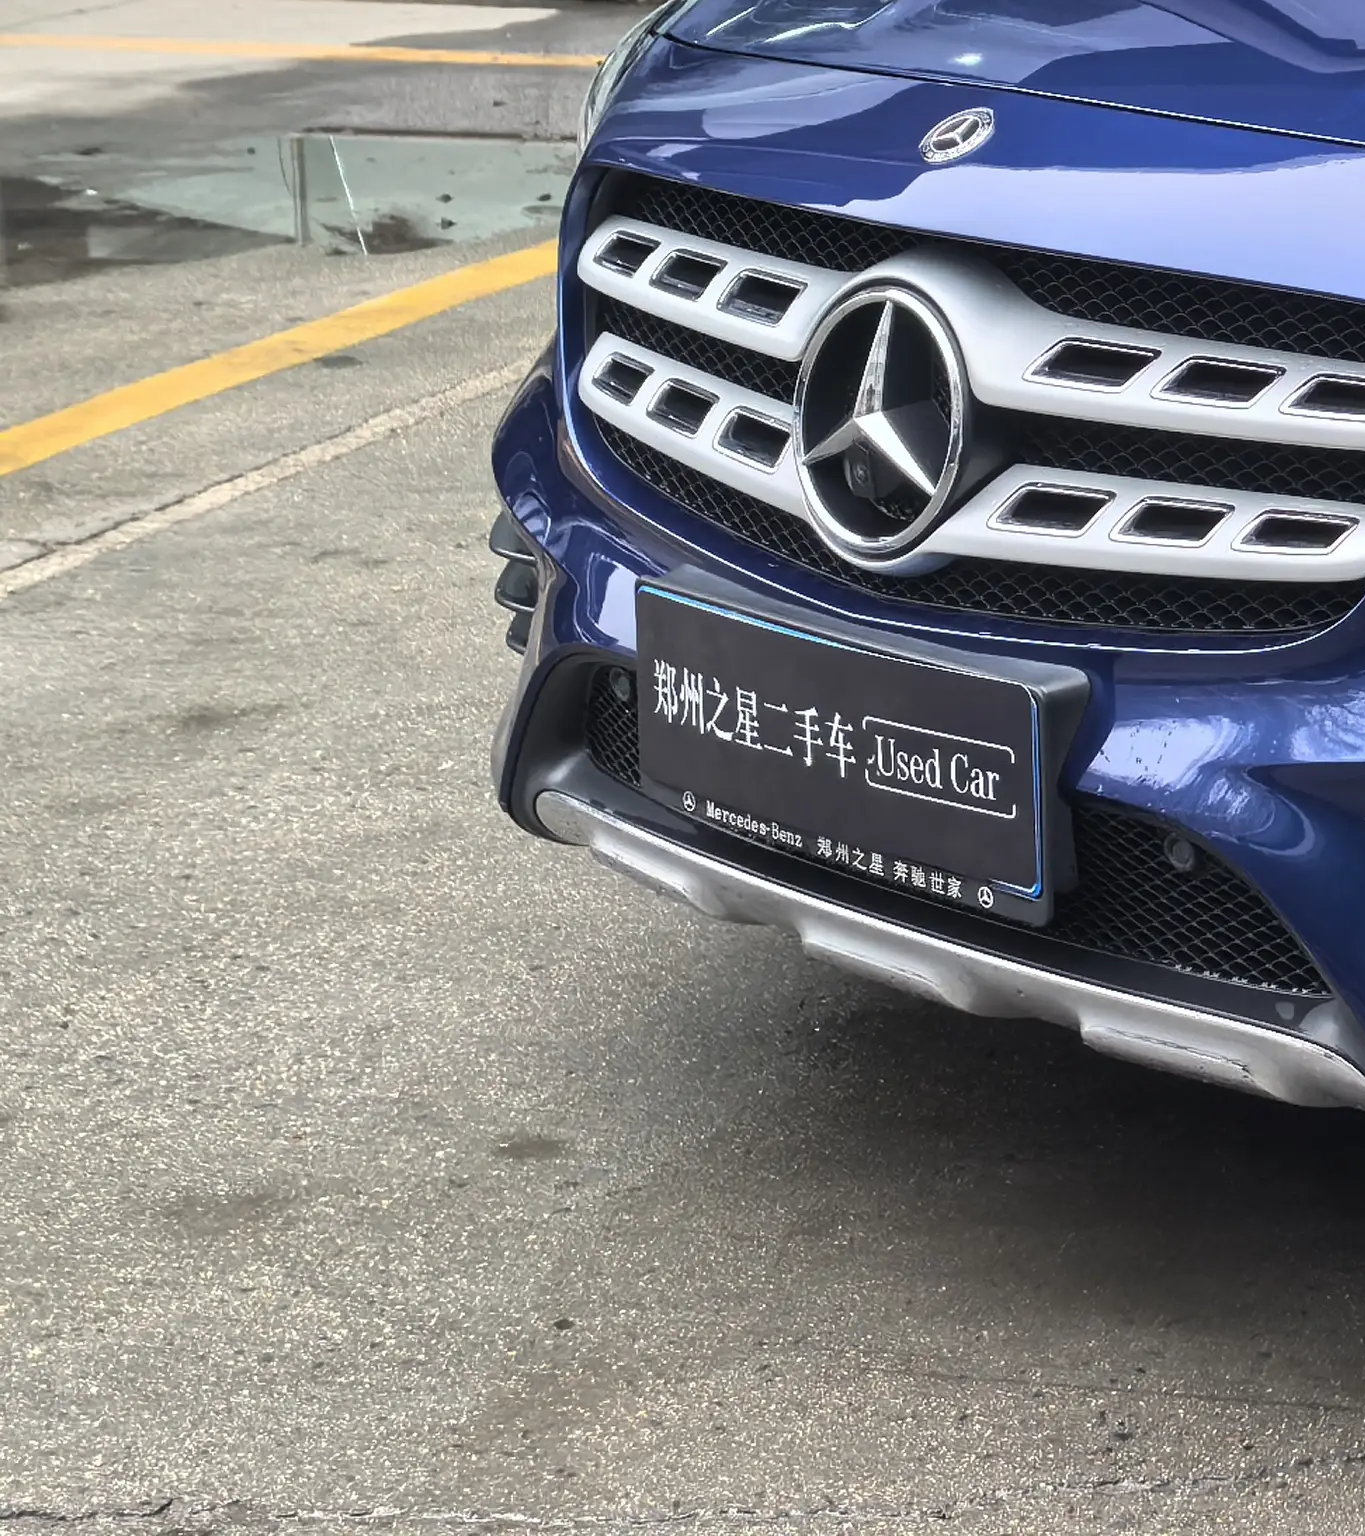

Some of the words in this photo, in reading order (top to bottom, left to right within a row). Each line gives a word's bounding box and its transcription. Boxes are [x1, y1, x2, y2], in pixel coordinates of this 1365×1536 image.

[653, 658, 857, 779] 郑州之星二手车
[874, 732, 943, 790] Used
[950, 753, 1001, 802] Car
[706, 800, 803, 849] Mercedes-Benz
[817, 835, 885, 877] 郑州之星
[893, 860, 963, 900] 奔驰世家
